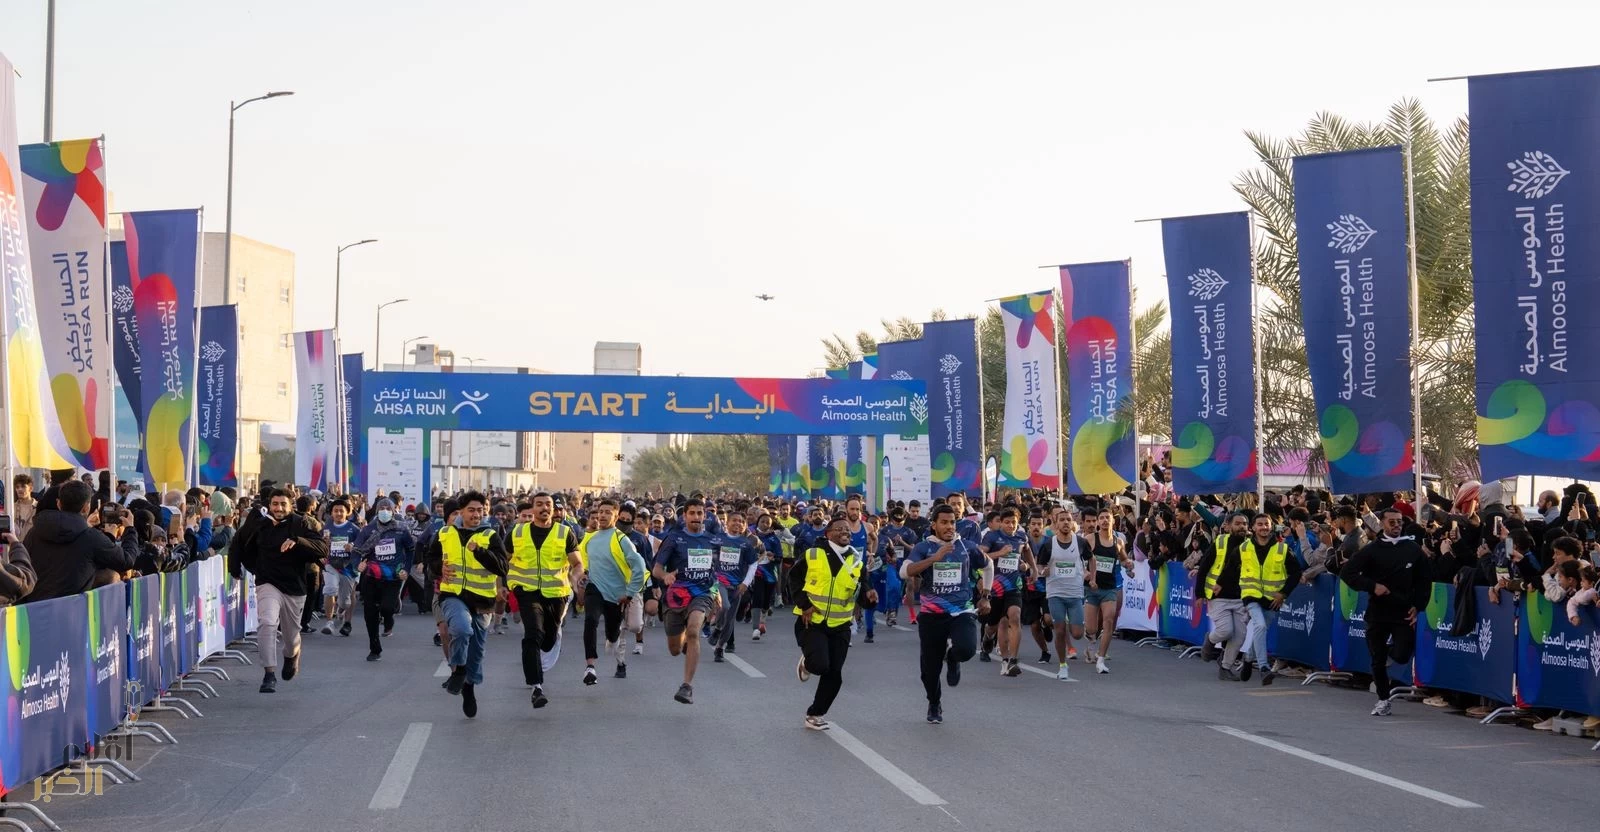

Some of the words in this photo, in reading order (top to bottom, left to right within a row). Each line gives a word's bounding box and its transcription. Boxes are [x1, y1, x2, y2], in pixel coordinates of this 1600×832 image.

[1515, 206, 1542, 288] الموسى
[1545, 203, 1565, 274] Health
[52, 252, 75, 307] الحسا
[75, 251, 90, 300] RUN
[1334, 259, 1356, 328] الموسى
[1357, 257, 1374, 316] Health
[81, 305, 93, 370] AHSA
[157, 301, 170, 346] الحسا
[168, 300, 177, 341] RUN
[1194, 304, 1212, 360] الموسى
[1213, 302, 1225, 350] Health
[1518, 295, 1544, 376] الصحية
[1549, 280, 1568, 373] Almoosa
[63, 312, 84, 373] تركض
[1088, 340, 1101, 378] الحسا
[1104, 338, 1117, 374] RUN
[1361, 321, 1376, 398] Almoosa
[162, 350, 177, 401] تركض
[171, 345, 184, 399] AHSA
[205, 365, 214, 401] الموسى
[214, 364, 224, 393] Health
[1022, 361, 1032, 395] الحسا
[1033, 360, 1041, 391] RUN
[1216, 354, 1228, 417] Almoosa
[1337, 334, 1358, 401] الصحية
[373, 387, 410, 402] تركض
[373, 403, 413, 415] AHSA
[416, 403, 446, 415] RUN
[413, 388, 446, 400] الحسا
[529, 391, 647, 417] START
[664, 391, 775, 420] البداية
[821, 395, 862, 408] الصحية
[864, 396, 907, 409] الموسى
[943, 377, 953, 413] الموسى
[953, 375, 961, 407] Health
[1089, 382, 1104, 424] تركض
[1106, 376, 1117, 423] AHSA
[1196, 365, 1213, 418] الصحية
[201, 403, 213, 439] الصحية
[213, 395, 222, 439] Almoosa
[821, 410, 868, 420] Almoosa
[871, 411, 907, 421] Health
[944, 415, 953, 450] الصحية
[955, 409, 963, 450] Almoosa
[1022, 399, 1035, 435] تركض
[1035, 394, 1044, 435] AHSA
[1170, 583, 1182, 601] تركض
[1181, 585, 1193, 600] الحسا
[1169, 603, 1182, 617] AHSA
[1182, 605, 1193, 620] RUN
[1348, 626, 1366, 638] Almoos
[1435, 636, 1458, 650] Almoosa
[1458, 640, 1477, 654] Health
[1542, 630, 1565, 648] الصحية
[1565, 633, 1590, 652] الموسى
[41, 660, 59, 689] الموسى
[1541, 651, 1567, 666] Almoosa
[1568, 654, 1589, 669] Health
[21, 665, 41, 694] الصحية
[21, 699, 43, 720] Almoosa
[43, 690, 59, 711] Health
